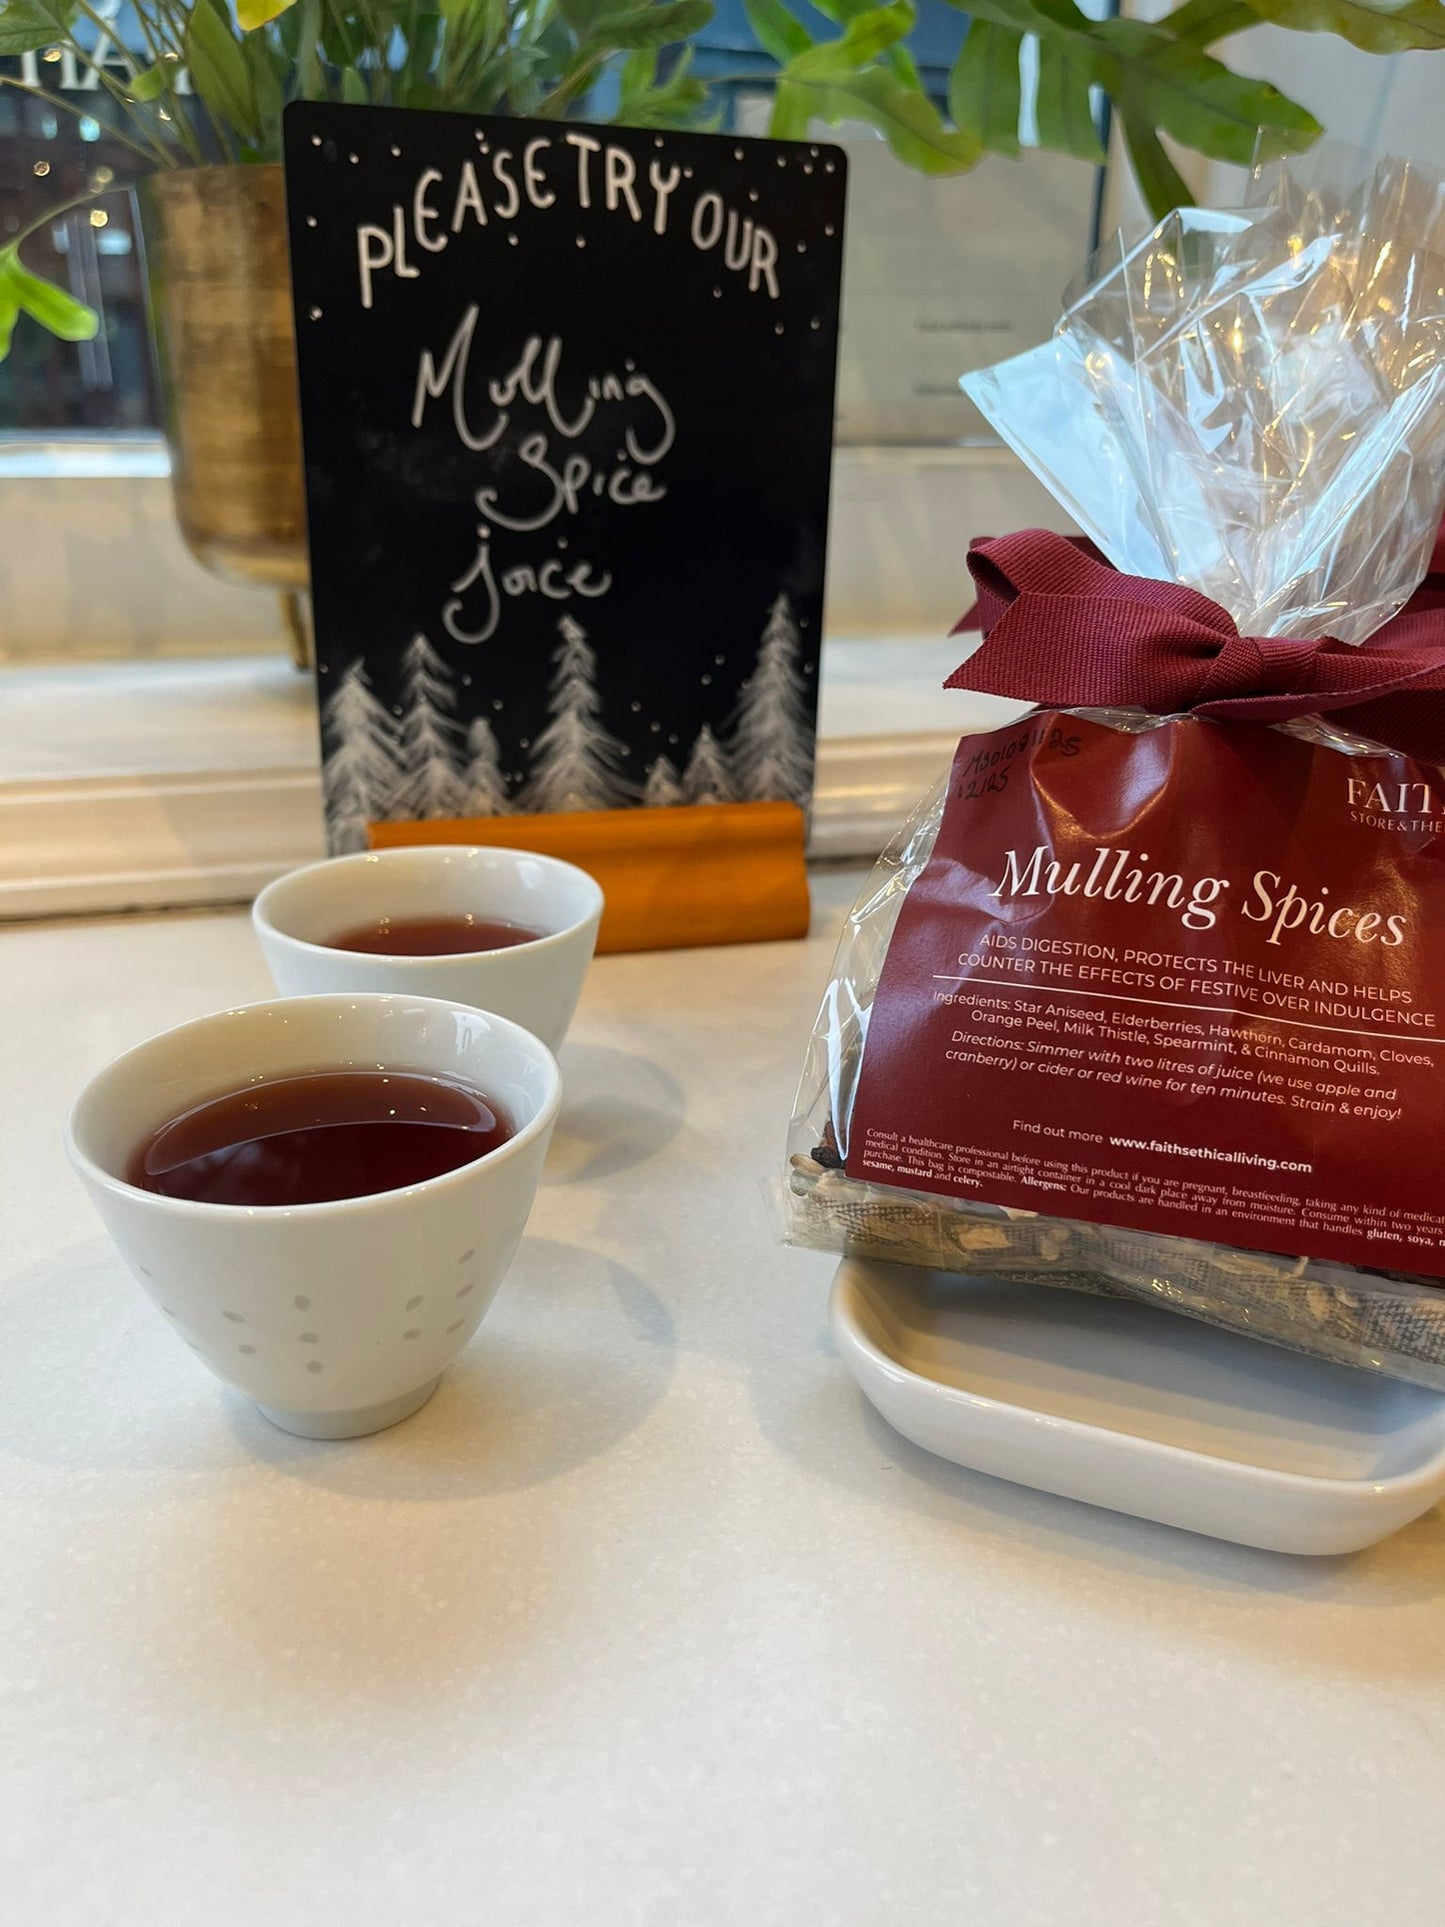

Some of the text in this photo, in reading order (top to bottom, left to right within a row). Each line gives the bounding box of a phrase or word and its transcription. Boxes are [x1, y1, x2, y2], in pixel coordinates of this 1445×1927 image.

[357, 131, 780, 308] PLEASE TRY OUR
[475, 432, 667, 531] Spice
[1346, 777, 1445, 815] FAIT
[988, 844, 1407, 947] Mulling Spices
[958, 953, 1436, 1027] COUNTER THE EFFECTS OF FESTIVE OVER INDULGENCE
[979, 934, 1412, 1004] AIDS DIGESTION, PROTECTS THE LIVER AND HELPS
[933, 990, 1434, 1067] Ingredients: Star Aniseed, Elderberries, Hawthorn, Cardamom, Cloves,
[952, 1030, 1397, 1101] Directions: Simmer with two litres of juice (we use apple and
[971, 1009, 1380, 1076] Orange Peel, Milk Thistle, Spearmint, & Cinnamon Quills.
[945, 1049, 1403, 1122] cranberry) or cider or red wine for ten minutes. Strain & enjoy!
[862, 1158, 983, 1188] sesame, mustard and celery.
[866, 1128, 898, 1141] Consult
[908, 1135, 953, 1151] healthcare
[955, 1144, 1009, 1160] professional
[1011, 1152, 1041, 1166] before
[1043, 1160, 1069, 1173] using
[1071, 1163, 1088, 1173] this
[1091, 1167, 1129, 1180] product
[1132, 1171, 1139, 1181] if
[1141, 1175, 1160, 1185] you
[1163, 1178, 1180, 1187] are
[1182, 1181, 1228, 1196] pregnant,
[1232, 1186, 1301, 1207] breastfeeding,
[1305, 1198, 1337, 1212] taking
[1340, 1203, 1359, 1214] any
[1363, 1204, 1387, 1217] kind
[1389, 1208, 1401, 1218] of
[1012, 1119, 1313, 1174] Find out more www.faithsethicalliving.com
[863, 1149, 903, 1163] purchase.
[907, 1155, 925, 1167] This
[928, 1158, 945, 1171] bag
[948, 1163, 955, 1171] is
[957, 1165, 1017, 1182] compostable.
[1020, 1175, 1067, 1192] Allergens:
[1070, 1183, 1090, 1195] Our
[1093, 1188, 1135, 1202] products
[1138, 1196, 1154, 1205] are
[1157, 1197, 1198, 1212] handled
[1201, 1204, 1212, 1213] in
[1215, 1208, 1228, 1216] an
[1231, 1211, 1295, 1226] environment
[1299, 1218, 1319, 1229] that
[1323, 1222, 1363, 1236] handles
[1366, 1228, 1403, 1242] gluten,
[1407, 1235, 1434, 1246] soya,
[865, 1139, 898, 1151] medical
[902, 1145, 945, 1159] condition.
[948, 1153, 971, 1165] Store
[974, 1157, 984, 1166] in
[986, 1161, 999, 1169] an
[1002, 1162, 1034, 1176] airtight
[1037, 1169, 1081, 1183] container
[1085, 1176, 1095, 1185] in
[1109, 1180, 1131, 1191] cool
[1134, 1184, 1156, 1195] dark
[1160, 1188, 1188, 1200] place
[1191, 1194, 1218, 1205] away
[1222, 1195, 1246, 1208] from
[1250, 1202, 1296, 1216] moisture.
[1301, 1208, 1350, 1223] Consume
[1354, 1216, 1387, 1228] within
[1391, 1220, 1412, 1231] two
[1415, 1224, 1443, 1236] years
